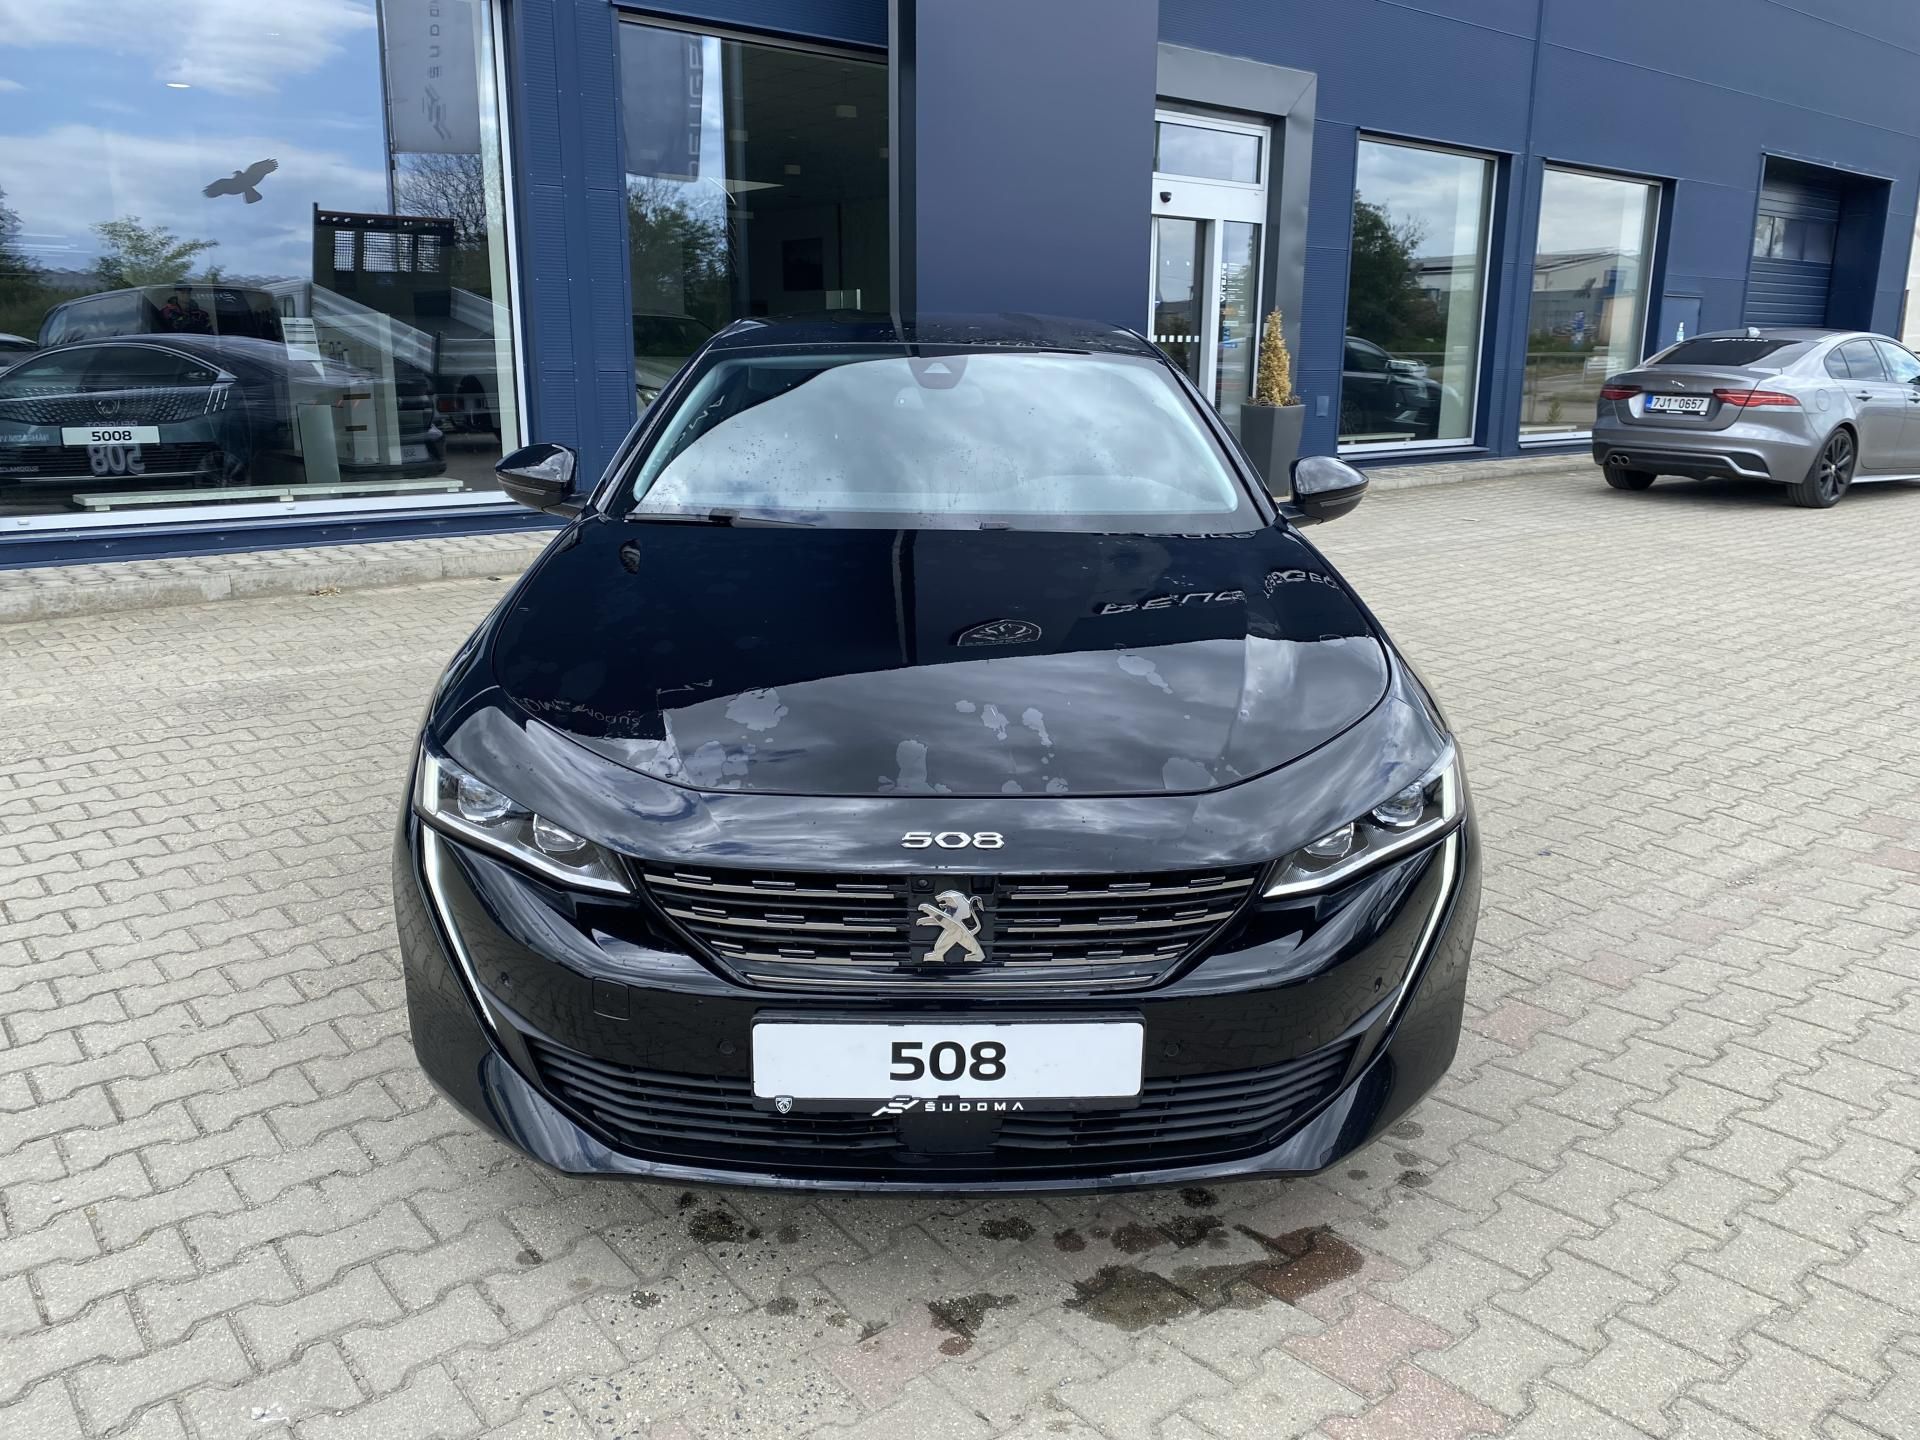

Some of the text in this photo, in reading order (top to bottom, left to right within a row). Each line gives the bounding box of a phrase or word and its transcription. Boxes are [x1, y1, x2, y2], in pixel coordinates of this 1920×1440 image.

[1653, 397, 1705, 410] 7J1 0657
[91, 430, 132, 442] 5008
[901, 832, 1004, 848] 508
[889, 1041, 1007, 1082] 508
[925, 1101, 1024, 1112] ŠUDOMA
